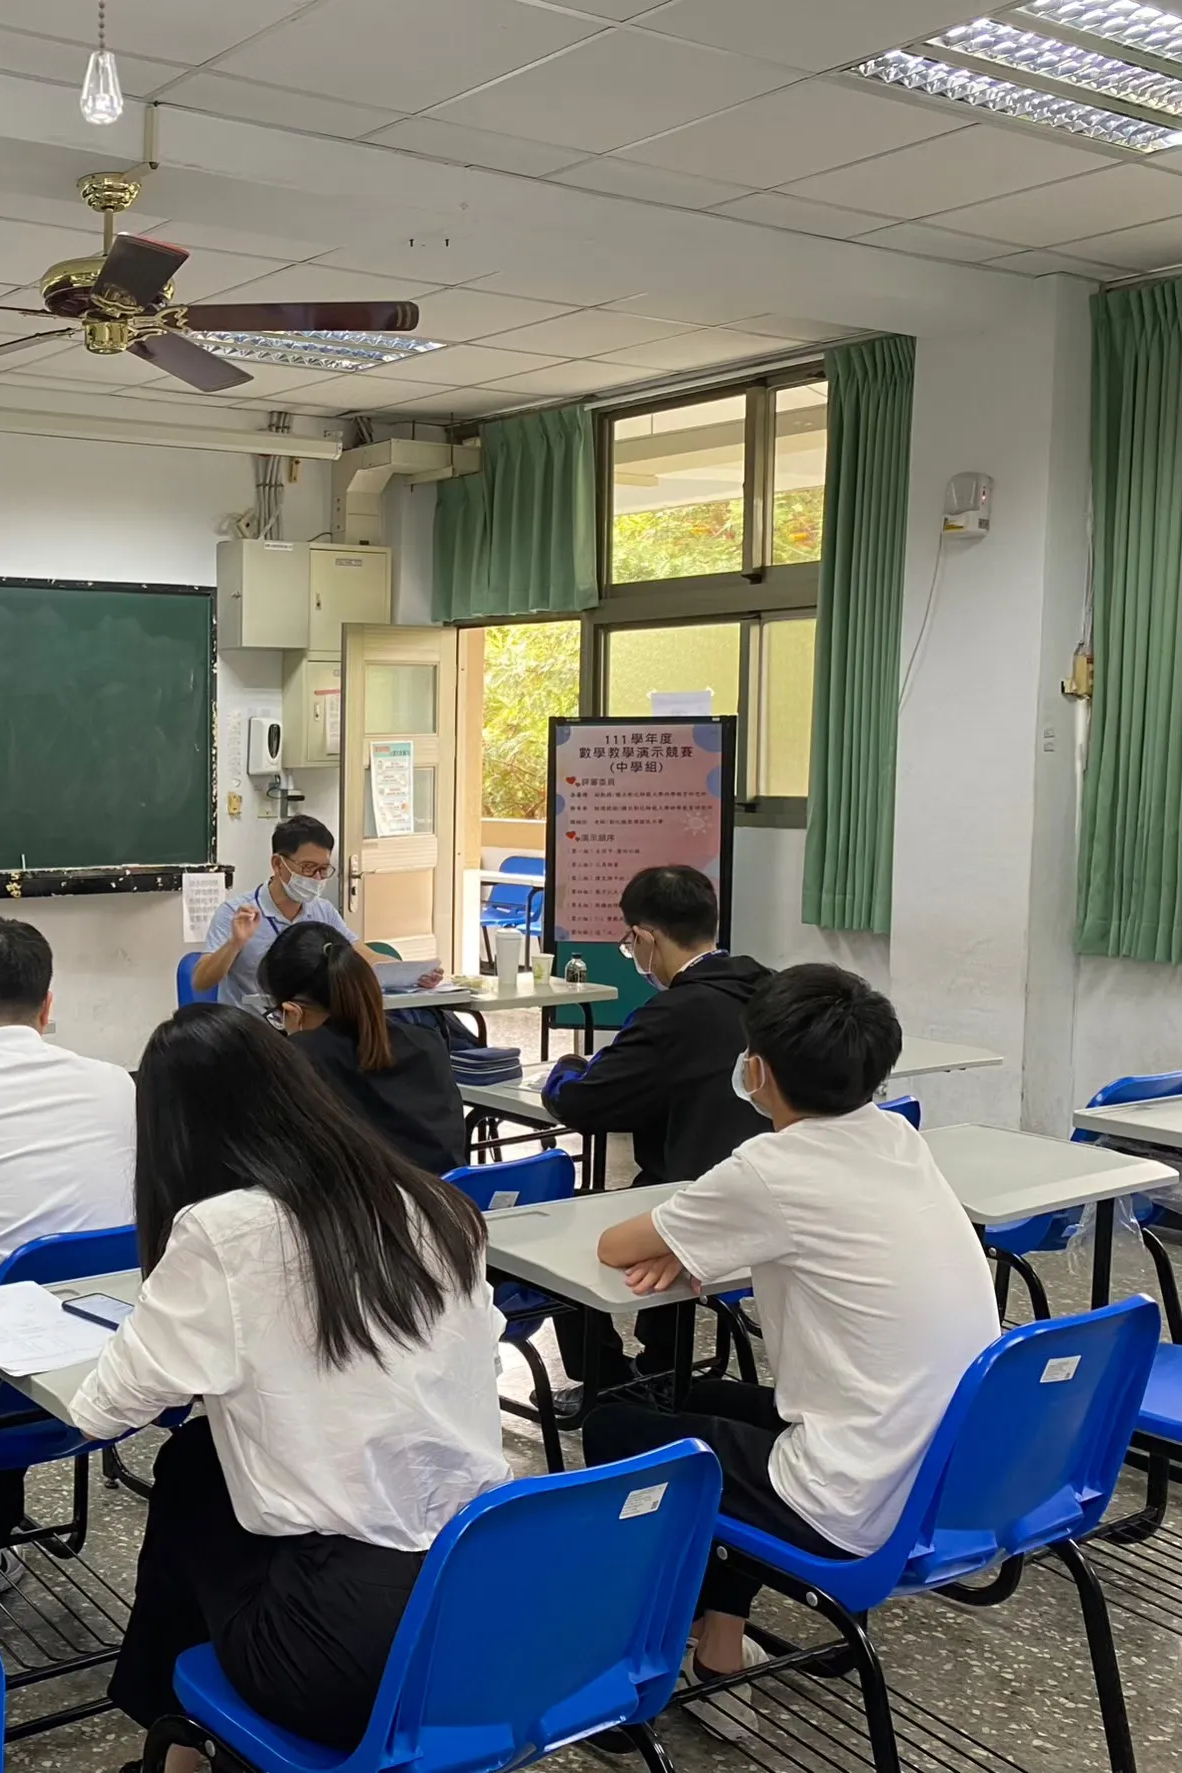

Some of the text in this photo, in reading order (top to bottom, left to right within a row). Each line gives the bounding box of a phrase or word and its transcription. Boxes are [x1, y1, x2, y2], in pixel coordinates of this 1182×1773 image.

[604, 732, 674, 746] 111學年度
[579, 746, 694, 759] 數學教學演示競賽
[609, 761, 664, 774] (中學組)
[581, 778, 616, 787] 評審委員
